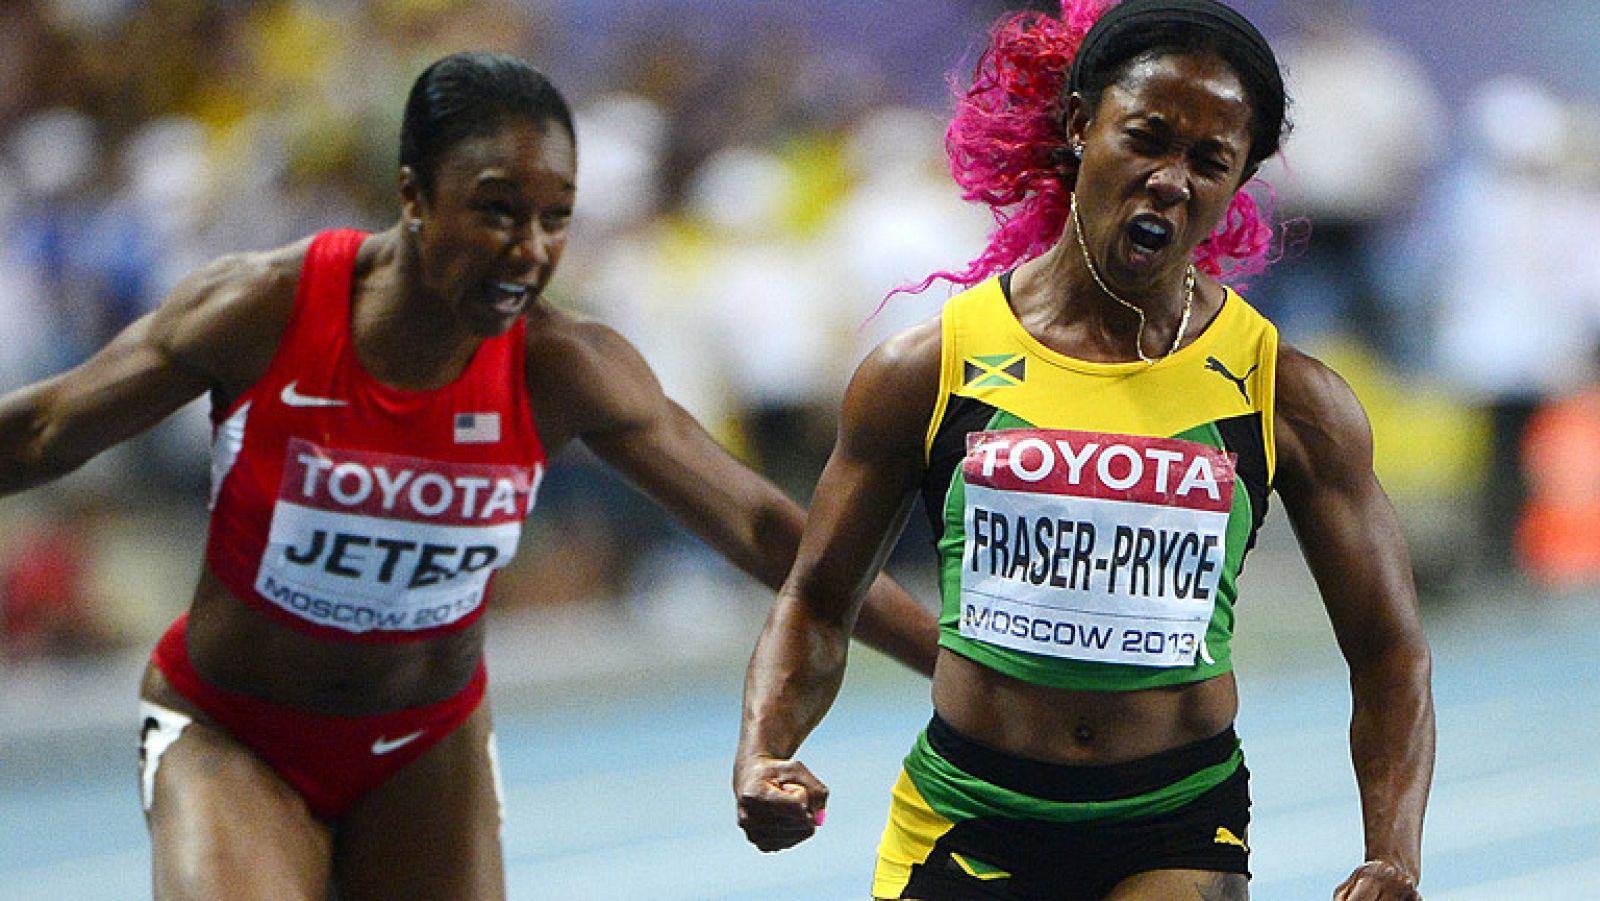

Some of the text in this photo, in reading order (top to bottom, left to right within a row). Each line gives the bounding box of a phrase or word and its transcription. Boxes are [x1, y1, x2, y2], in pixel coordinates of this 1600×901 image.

[297, 453, 517, 518] TOYOTA
[978, 438, 1220, 501] TOYOTA
[972, 508, 1218, 600] FRASER-PRYCE
[266, 577, 408, 627] MOSCOW
[966, 604, 1195, 654] MOSCOW 2013
